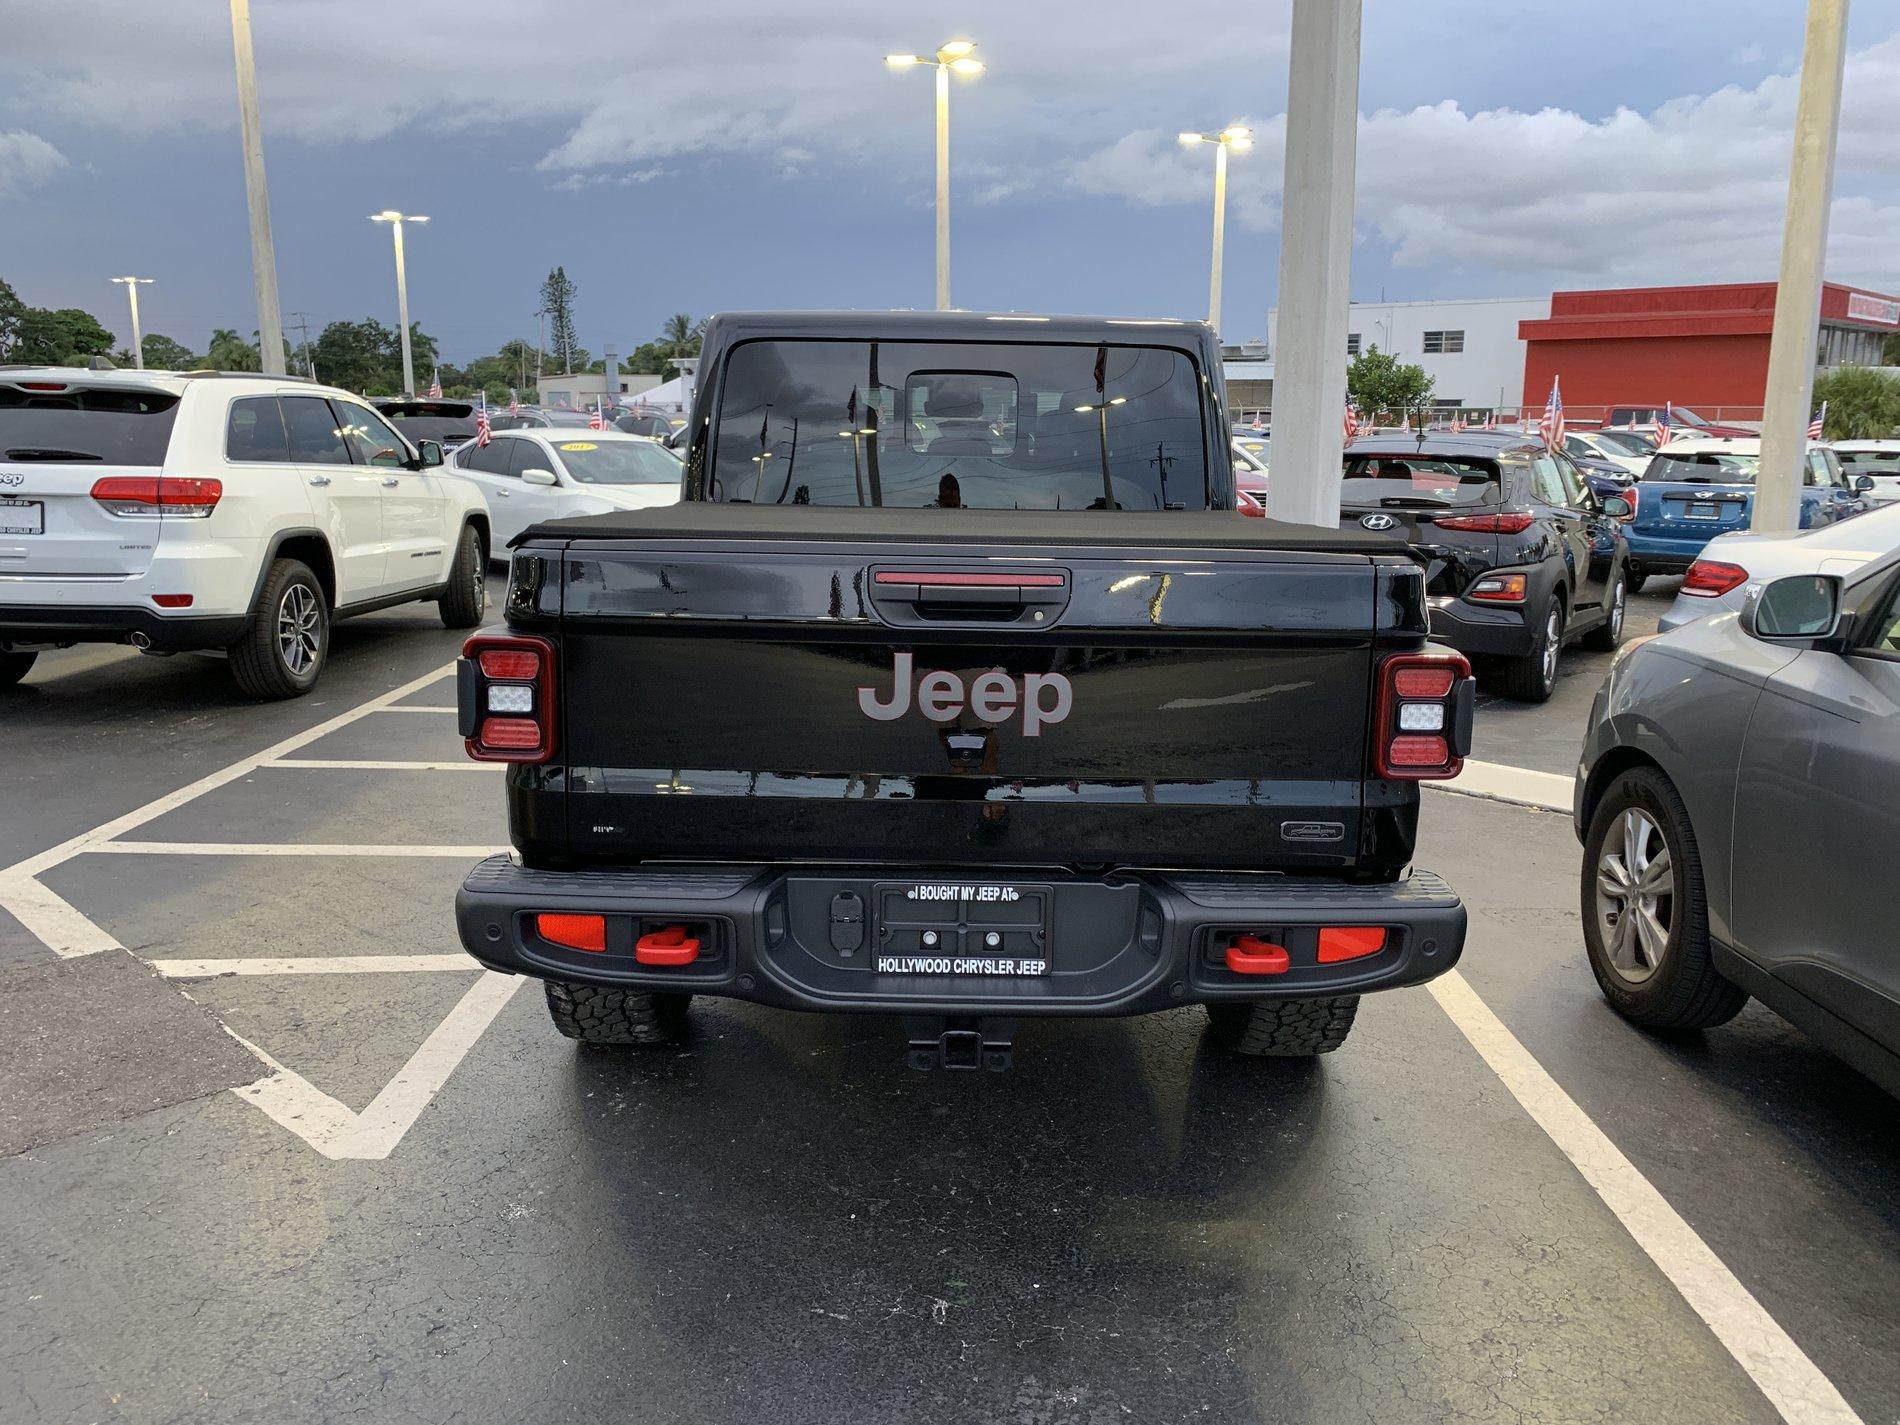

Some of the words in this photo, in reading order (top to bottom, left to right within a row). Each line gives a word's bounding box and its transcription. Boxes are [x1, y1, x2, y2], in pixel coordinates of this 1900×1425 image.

[857, 652, 1073, 738] Jeep
[920, 885, 960, 900] BOUGHT
[961, 886, 975, 901] MY
[976, 886, 999, 901] JEEP
[1001, 887, 1013, 902] AT
[878, 958, 951, 973] HOLLYWOOD
[953, 959, 1014, 974] CHRYSLER
[1016, 960, 1046, 975] JEEP
